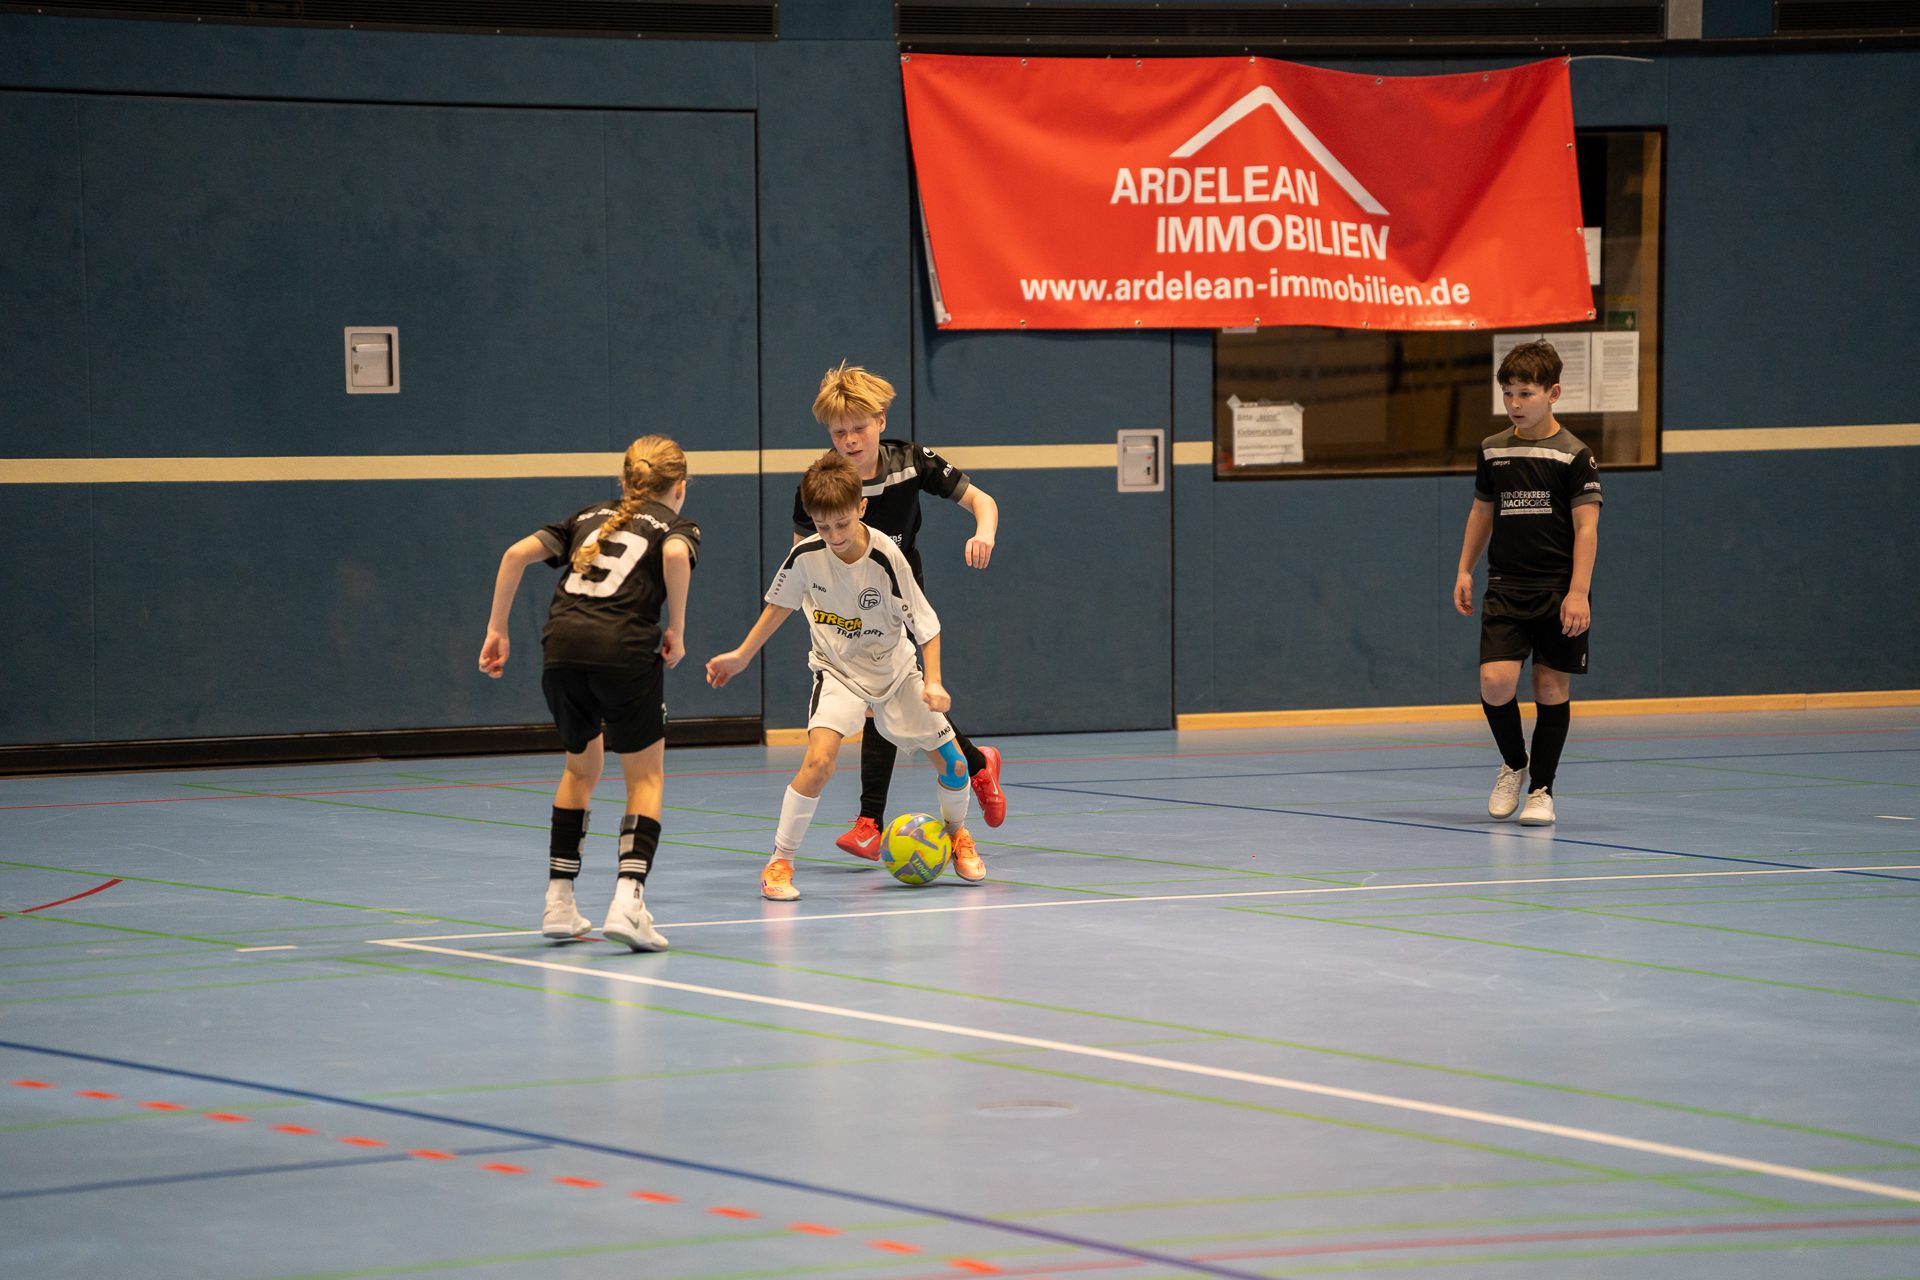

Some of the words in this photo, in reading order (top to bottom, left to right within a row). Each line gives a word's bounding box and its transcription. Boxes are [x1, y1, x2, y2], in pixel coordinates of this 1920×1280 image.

[1110, 165, 1319, 206] ARDELEAN
[1156, 213, 1390, 260] IMMOBILIEN
[1020, 268, 1471, 306] www.ardelean-immobilien.de
[1503, 490, 1551, 500] KINDERKREBS
[1503, 499, 1551, 508] NACHSORGE
[836, 627, 885, 640] TRANORT
